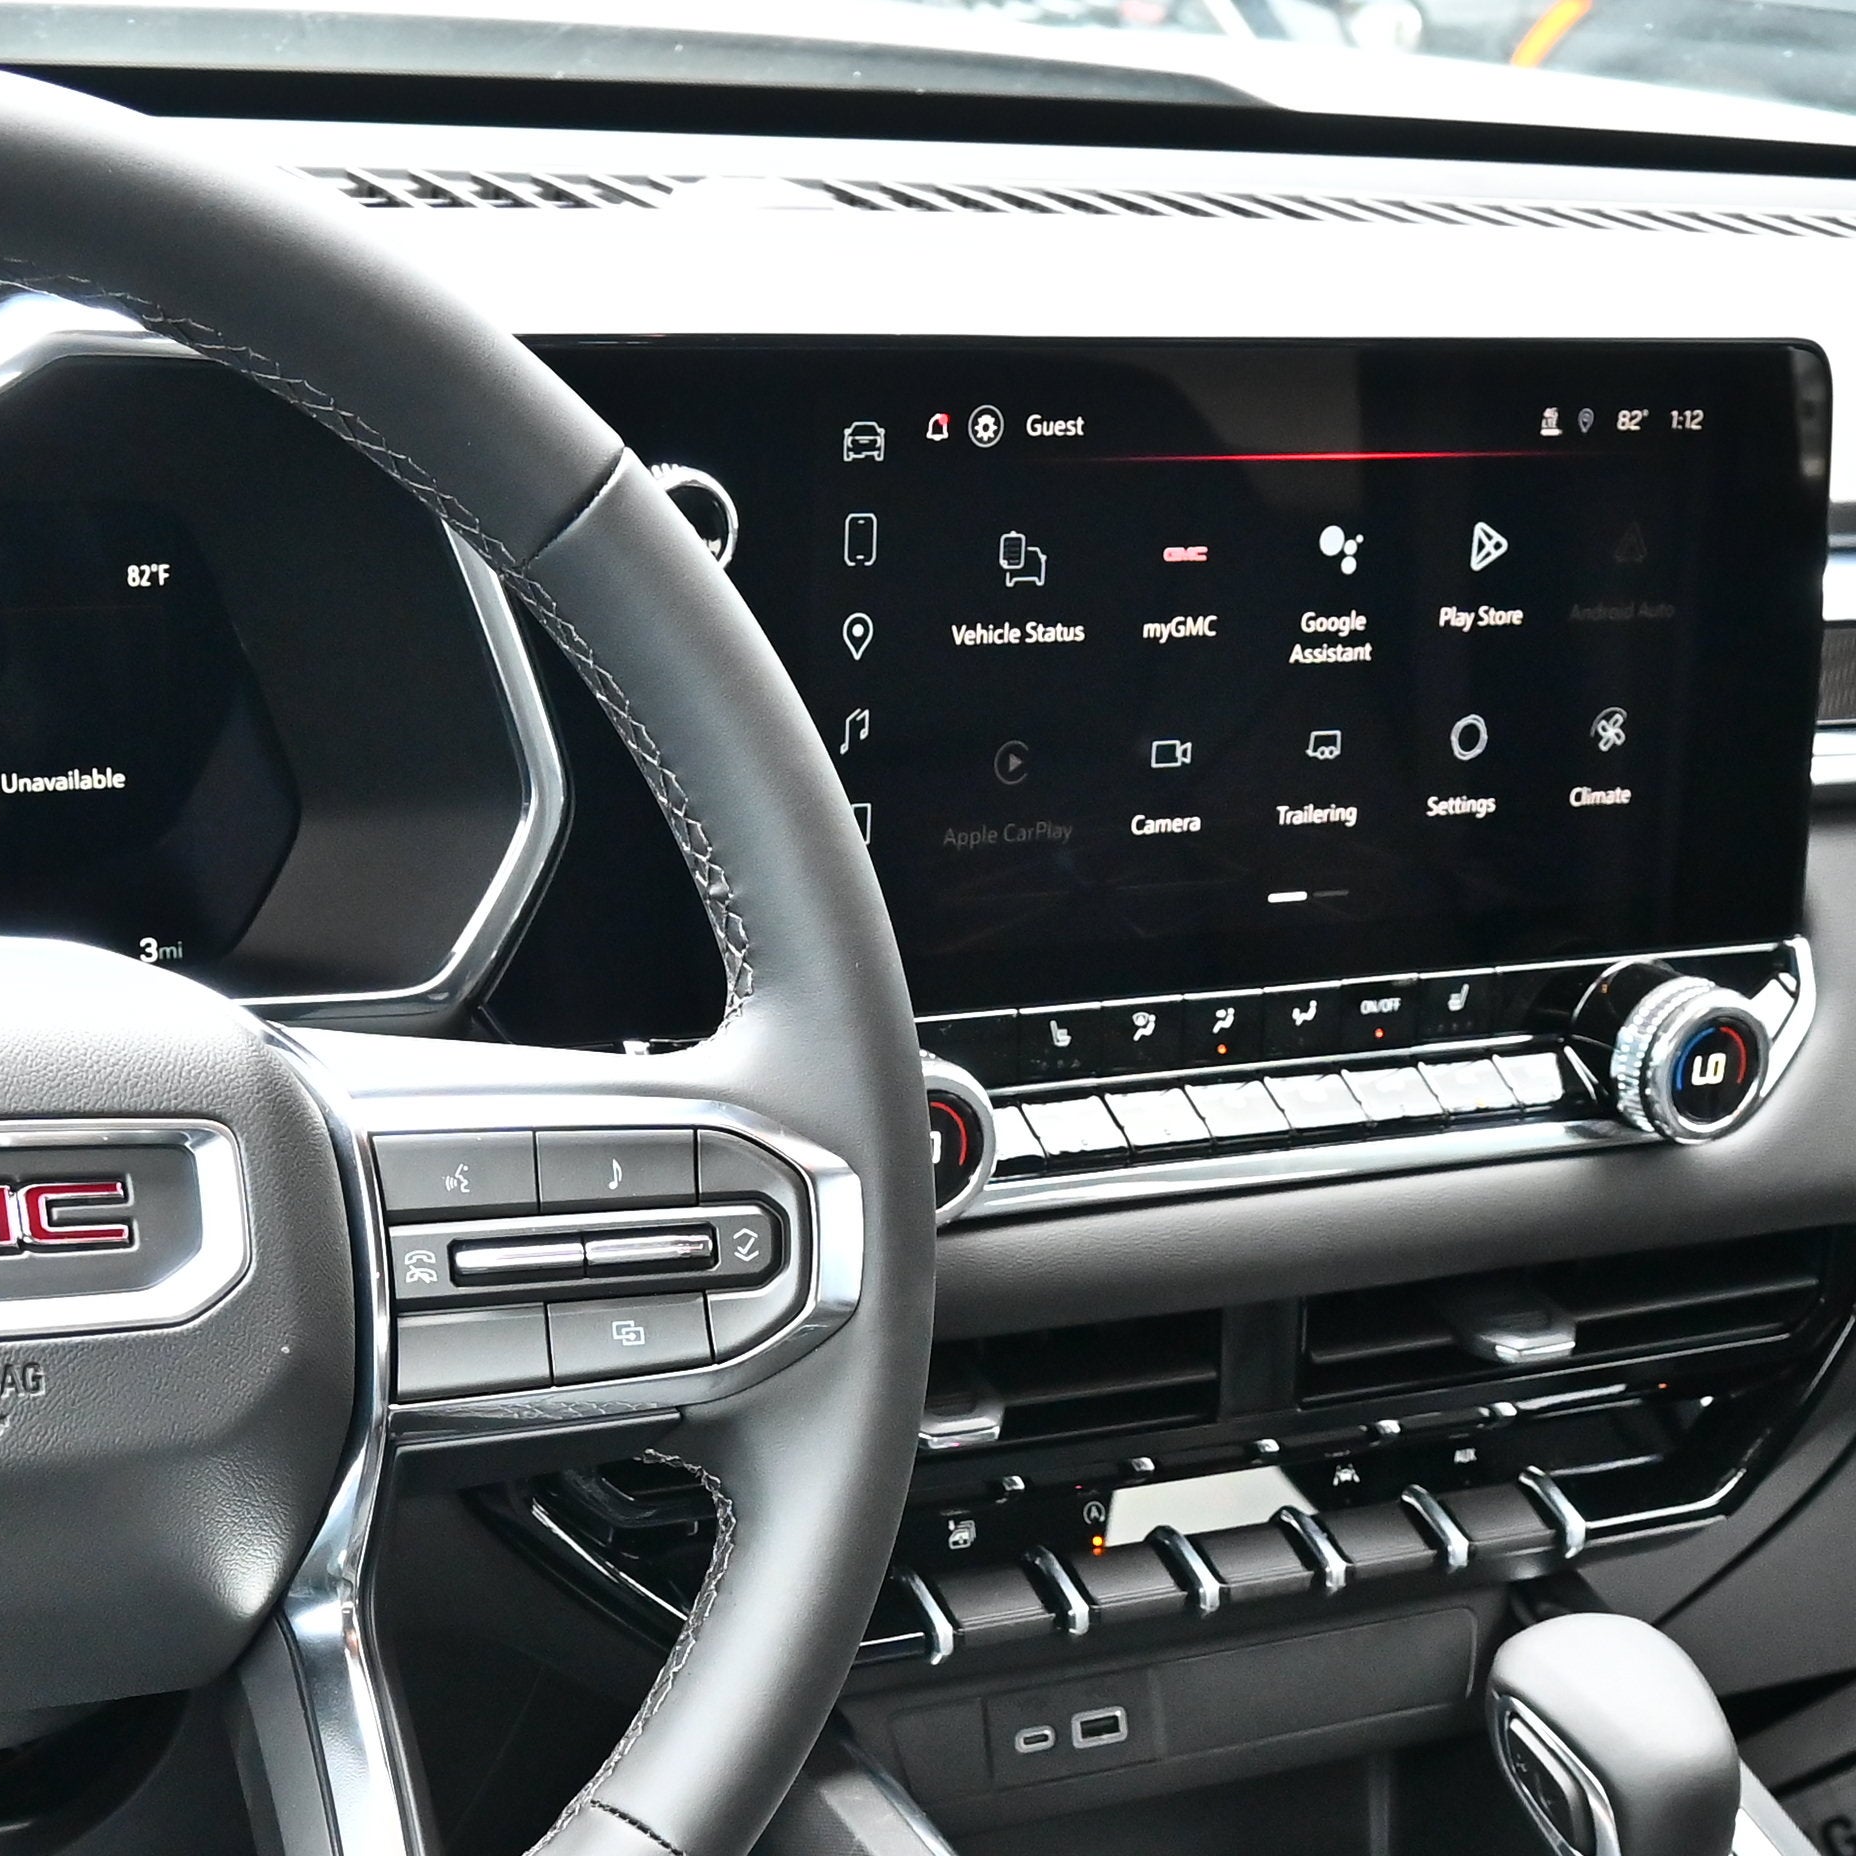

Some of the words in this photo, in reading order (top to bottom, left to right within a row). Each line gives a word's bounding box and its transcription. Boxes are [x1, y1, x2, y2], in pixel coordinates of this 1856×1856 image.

[1026, 414, 1084, 439] Guest
[1617, 409, 1649, 430] 82°
[1670, 409, 1704, 430] 1:12
[126, 564, 169, 588] 82°F
[1143, 615, 1218, 644] myGMC
[1300, 610, 1366, 636] Google
[1438, 606, 1474, 631] Play
[1477, 605, 1523, 627] Store
[952, 622, 1021, 647] Vehicle
[1025, 620, 1085, 644] Status
[1290, 642, 1371, 665] Assistant
[1, 767, 126, 795] Unavailable
[1427, 793, 1497, 819] Settings
[1570, 785, 1632, 809] Climate
[1131, 811, 1202, 837] Camera
[1277, 802, 1358, 829] Trailering
[944, 824, 998, 849] Apple
[1003, 818, 1074, 846] CarPlay
